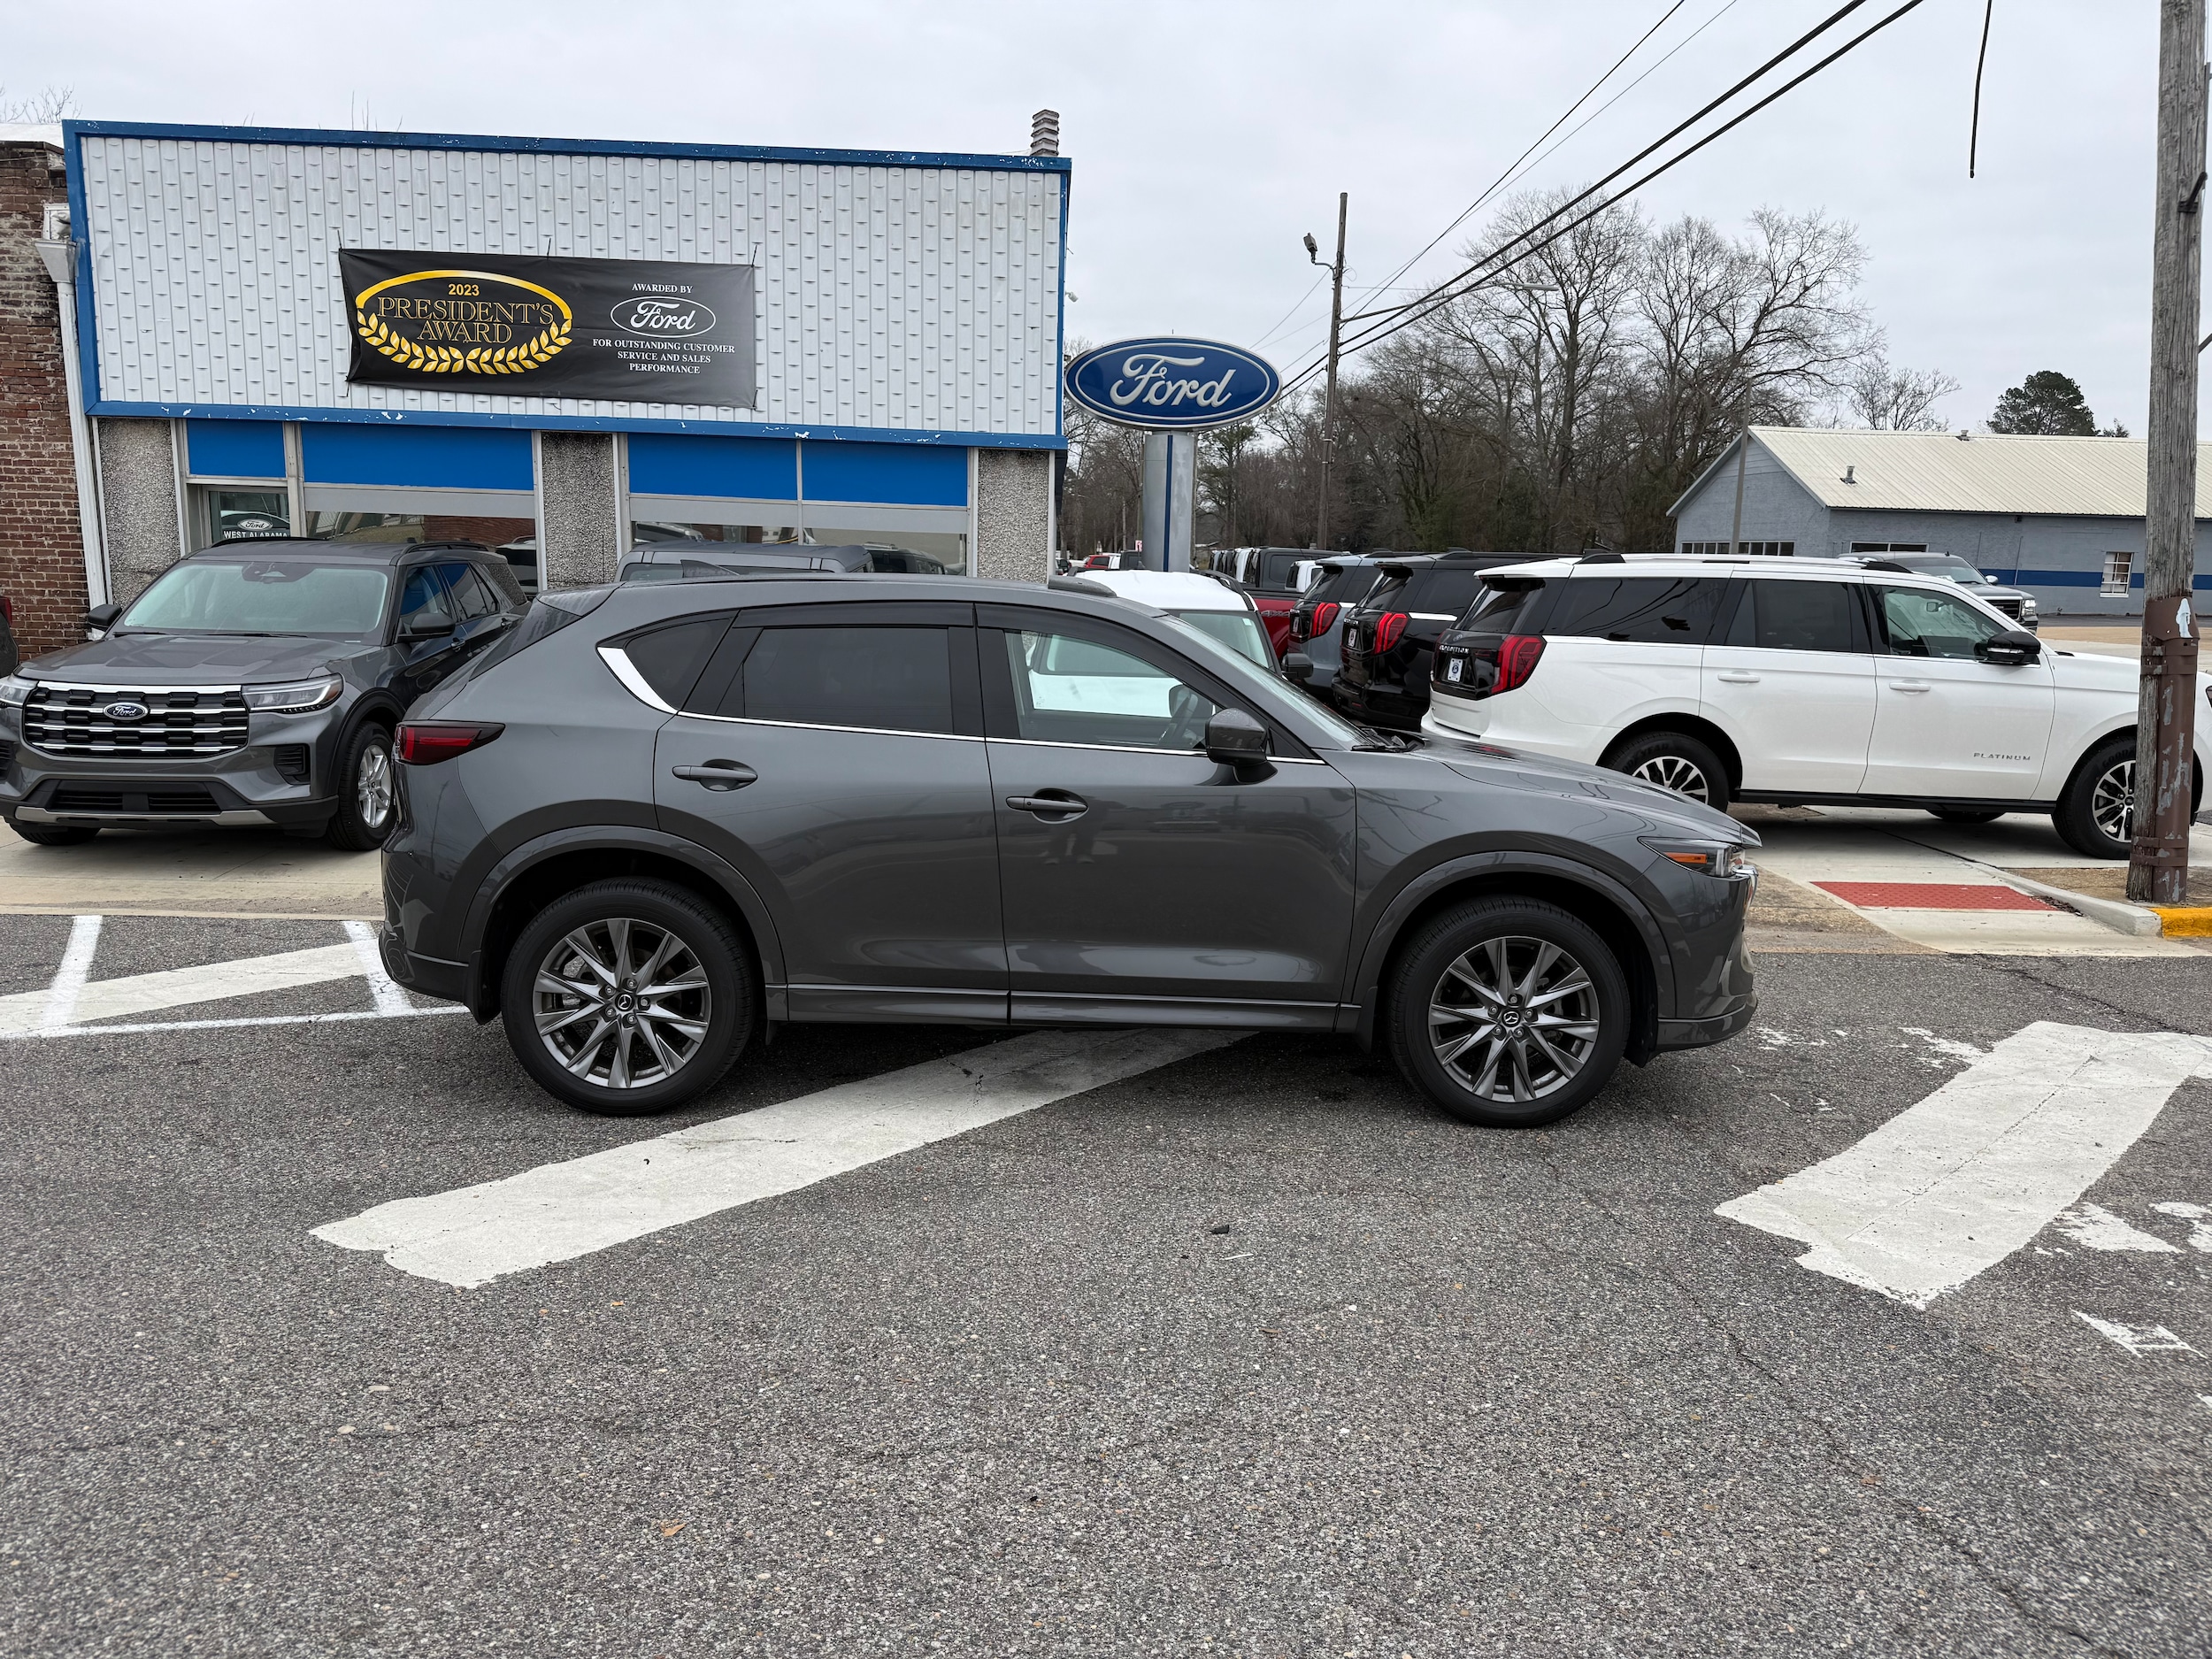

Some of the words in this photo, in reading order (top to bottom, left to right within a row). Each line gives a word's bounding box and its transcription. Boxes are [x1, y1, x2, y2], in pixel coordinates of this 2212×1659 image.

[448, 283, 480, 296] 2023
[632, 283, 678, 293] AWARDED
[630, 301, 696, 330] Ford
[417, 319, 512, 343] AWARD
[593, 338, 612, 347] FOR
[614, 340, 681, 350] OUTSTANDING
[683, 343, 735, 353] CUSTOMER
[618, 350, 658, 360] SERVICE
[629, 363, 701, 374] PERFORMANCE
[1110, 354, 1236, 408] Ford
[112, 705, 137, 716] Ford
[1973, 752, 2031, 761] PLATINUM
